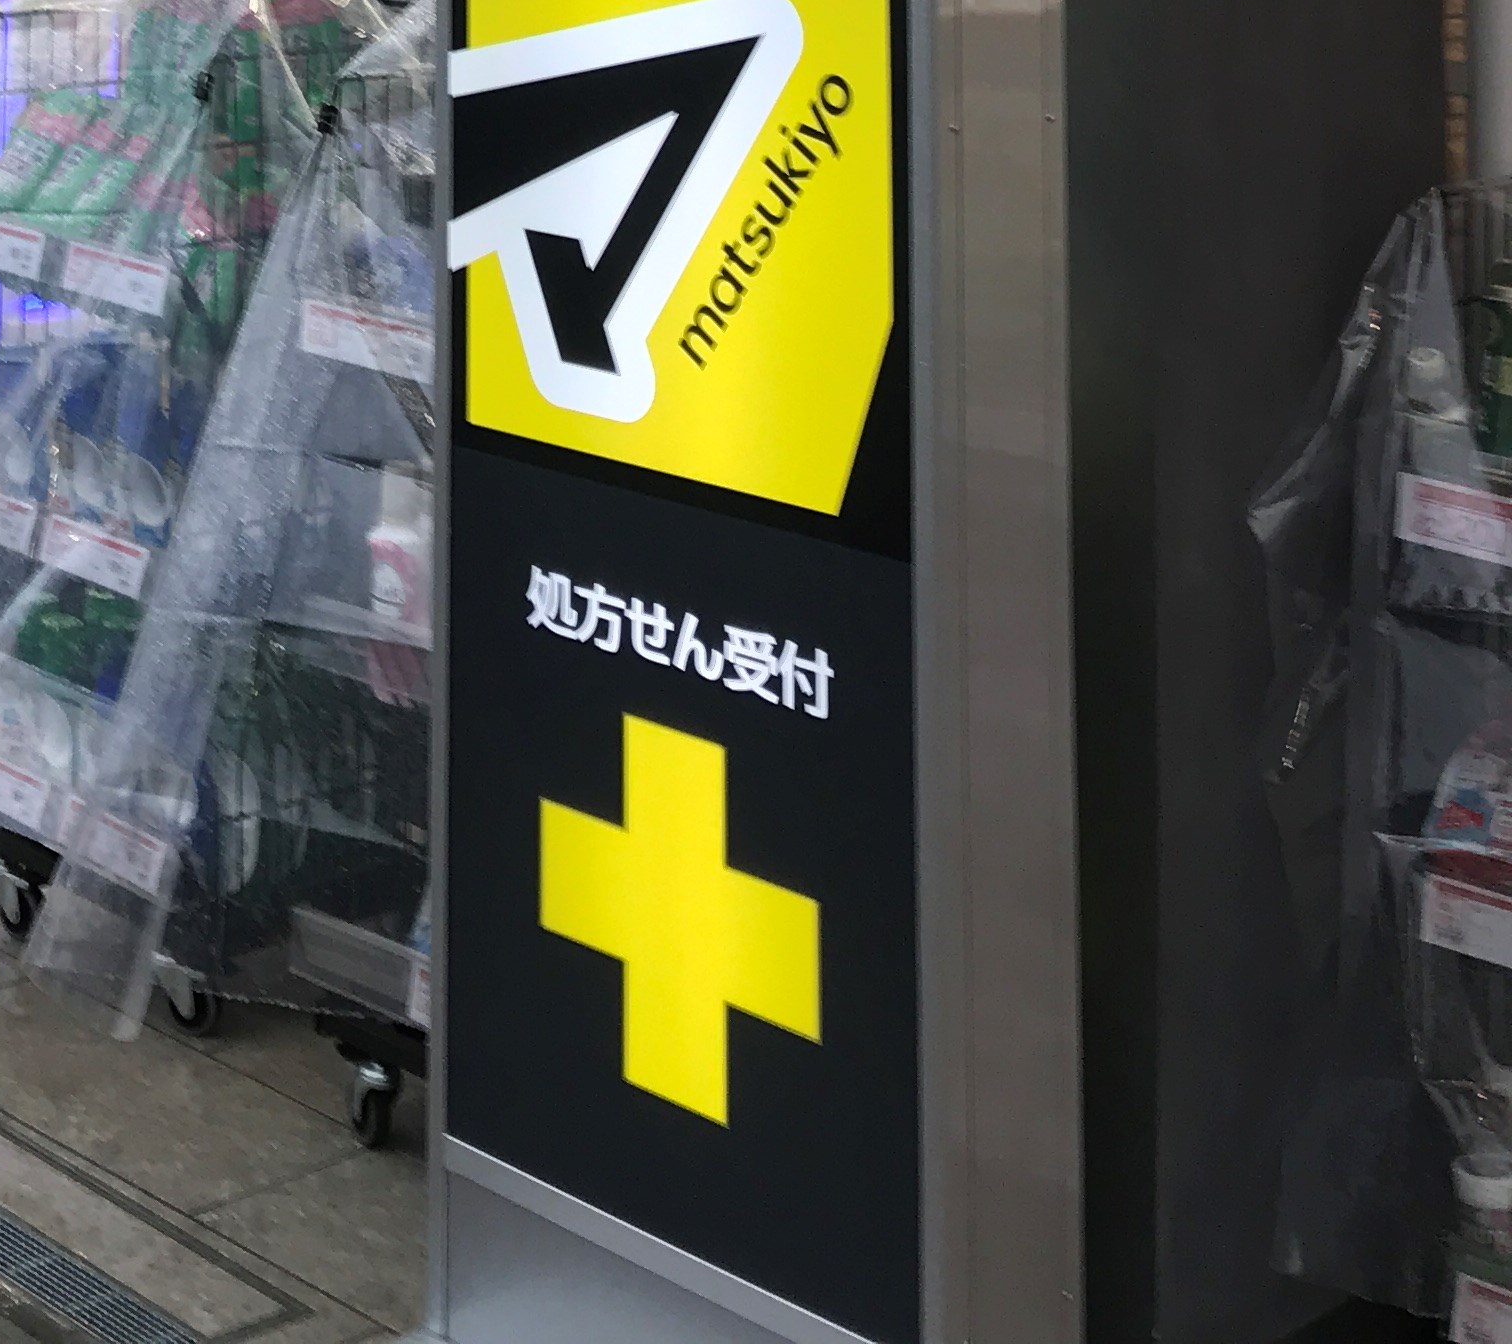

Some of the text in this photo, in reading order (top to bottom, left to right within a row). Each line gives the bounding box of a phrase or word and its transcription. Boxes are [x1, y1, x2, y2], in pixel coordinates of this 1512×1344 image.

[677, 73, 855, 371] matsukiyo
[524, 564, 836, 721] 処方せん受付
